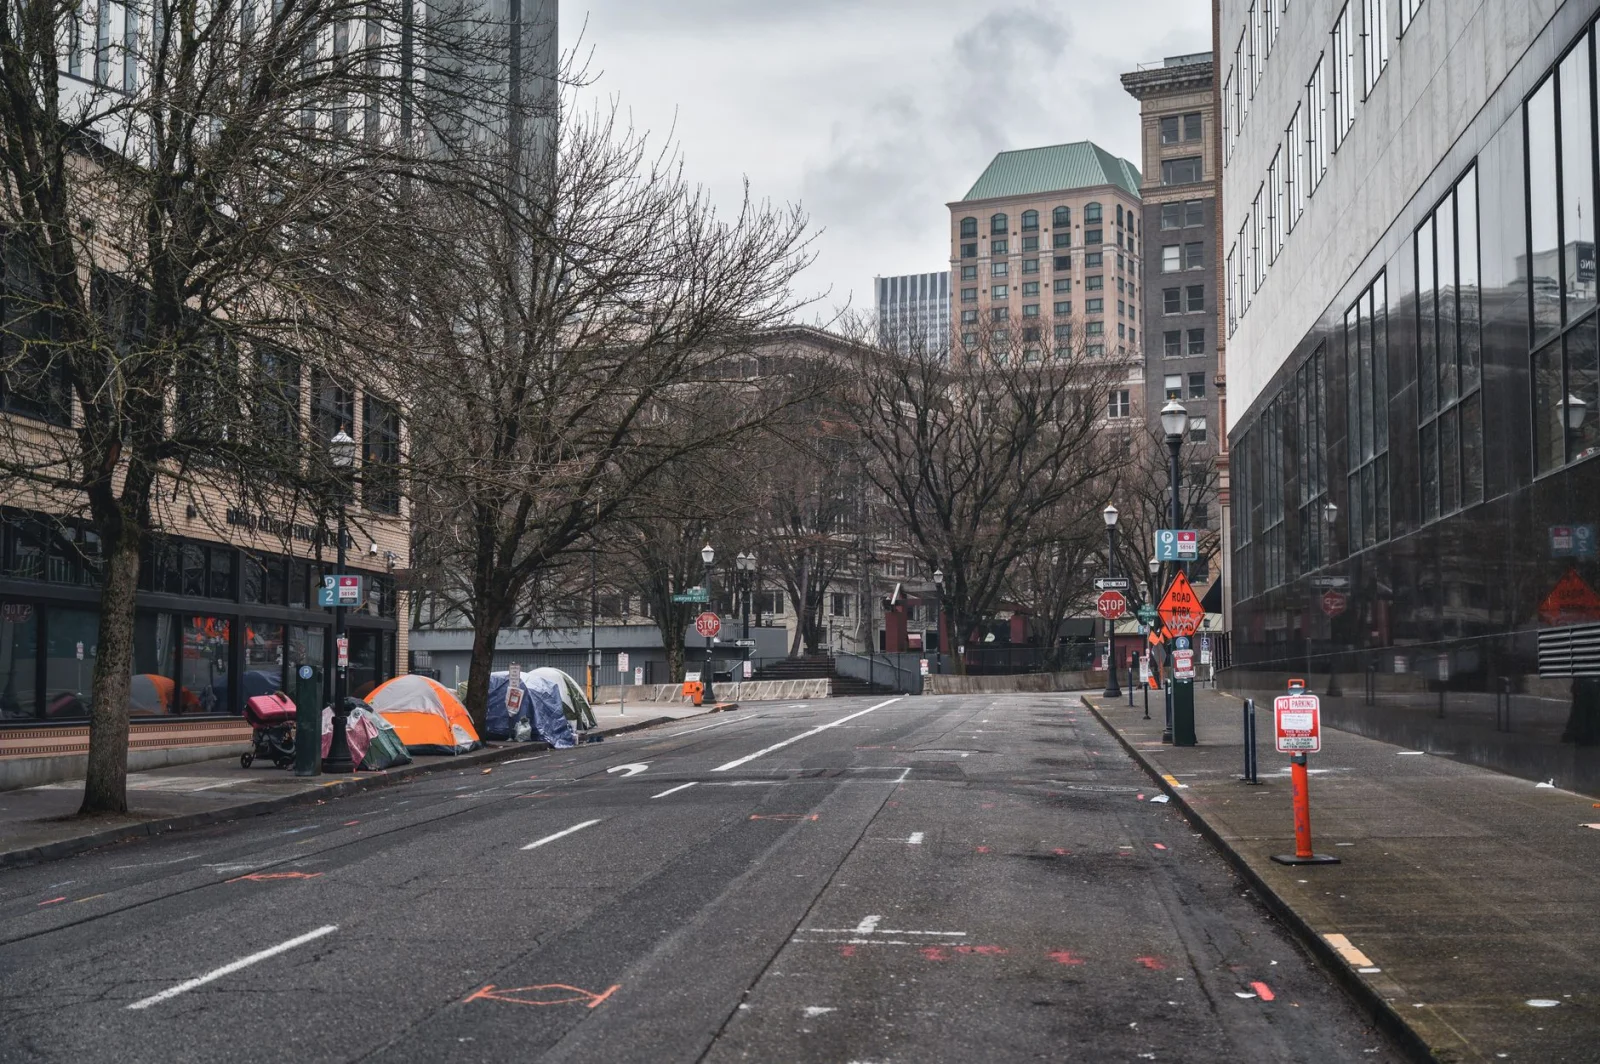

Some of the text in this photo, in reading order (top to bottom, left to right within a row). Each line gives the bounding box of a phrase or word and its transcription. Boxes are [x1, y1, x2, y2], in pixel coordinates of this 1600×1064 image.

[1164, 545, 1172, 556] 2
[325, 590, 334, 602] 2
[1172, 592, 1191, 603] ROAD
[1099, 600, 1124, 611] STOP
[1171, 606, 1191, 616] WORK
[698, 620, 719, 630] STOP
[303, 668, 310, 677] P
[1278, 699, 1315, 710] NO PARKING
